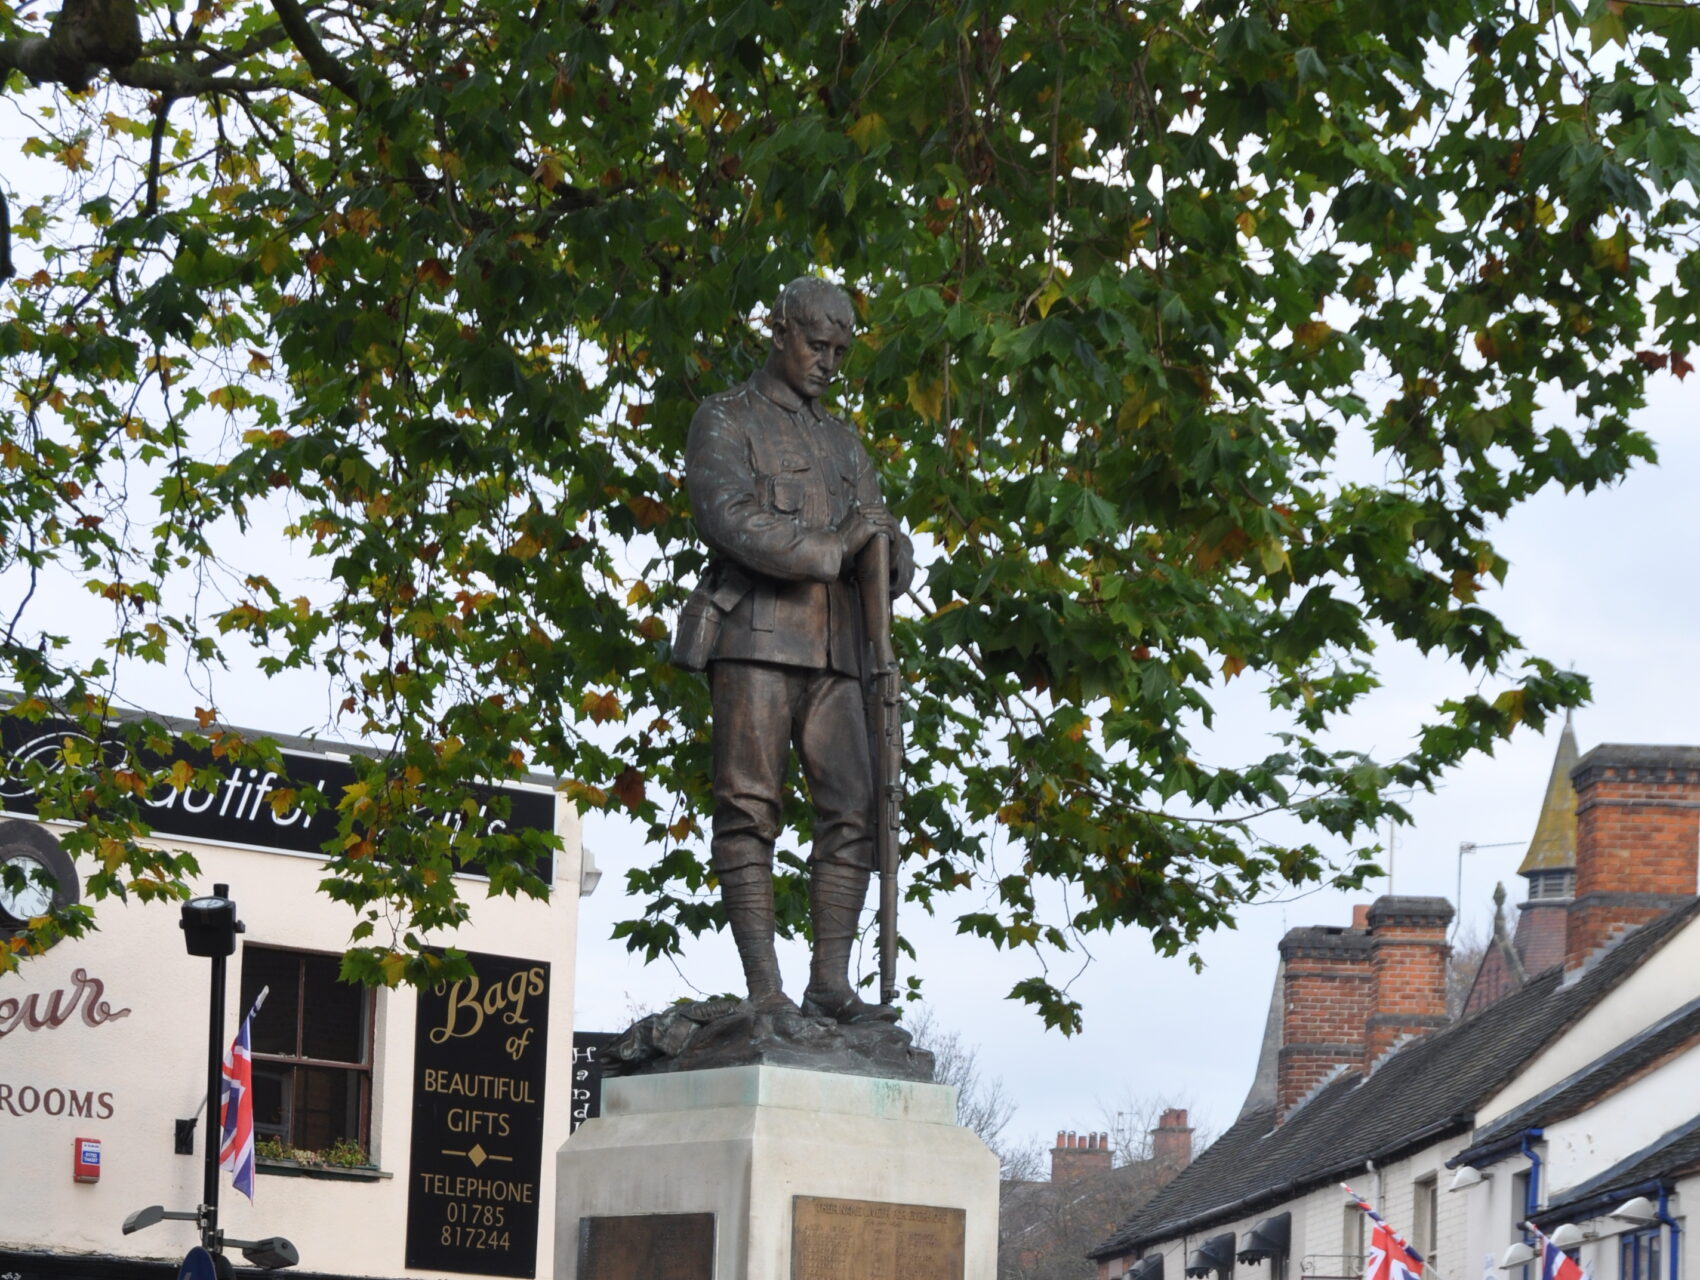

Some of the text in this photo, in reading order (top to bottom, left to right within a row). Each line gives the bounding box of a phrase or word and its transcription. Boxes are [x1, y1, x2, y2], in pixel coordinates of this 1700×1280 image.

[430, 967, 545, 1043] Bags
[506, 1027, 533, 1060] of
[424, 1069, 535, 1103] BEAUTIFUL
[447, 1108, 510, 1137] GIFTS
[420, 1173, 533, 1203] TELEPHONE
[447, 1201, 504, 1227] 01785
[441, 1225, 511, 1250] 817244
